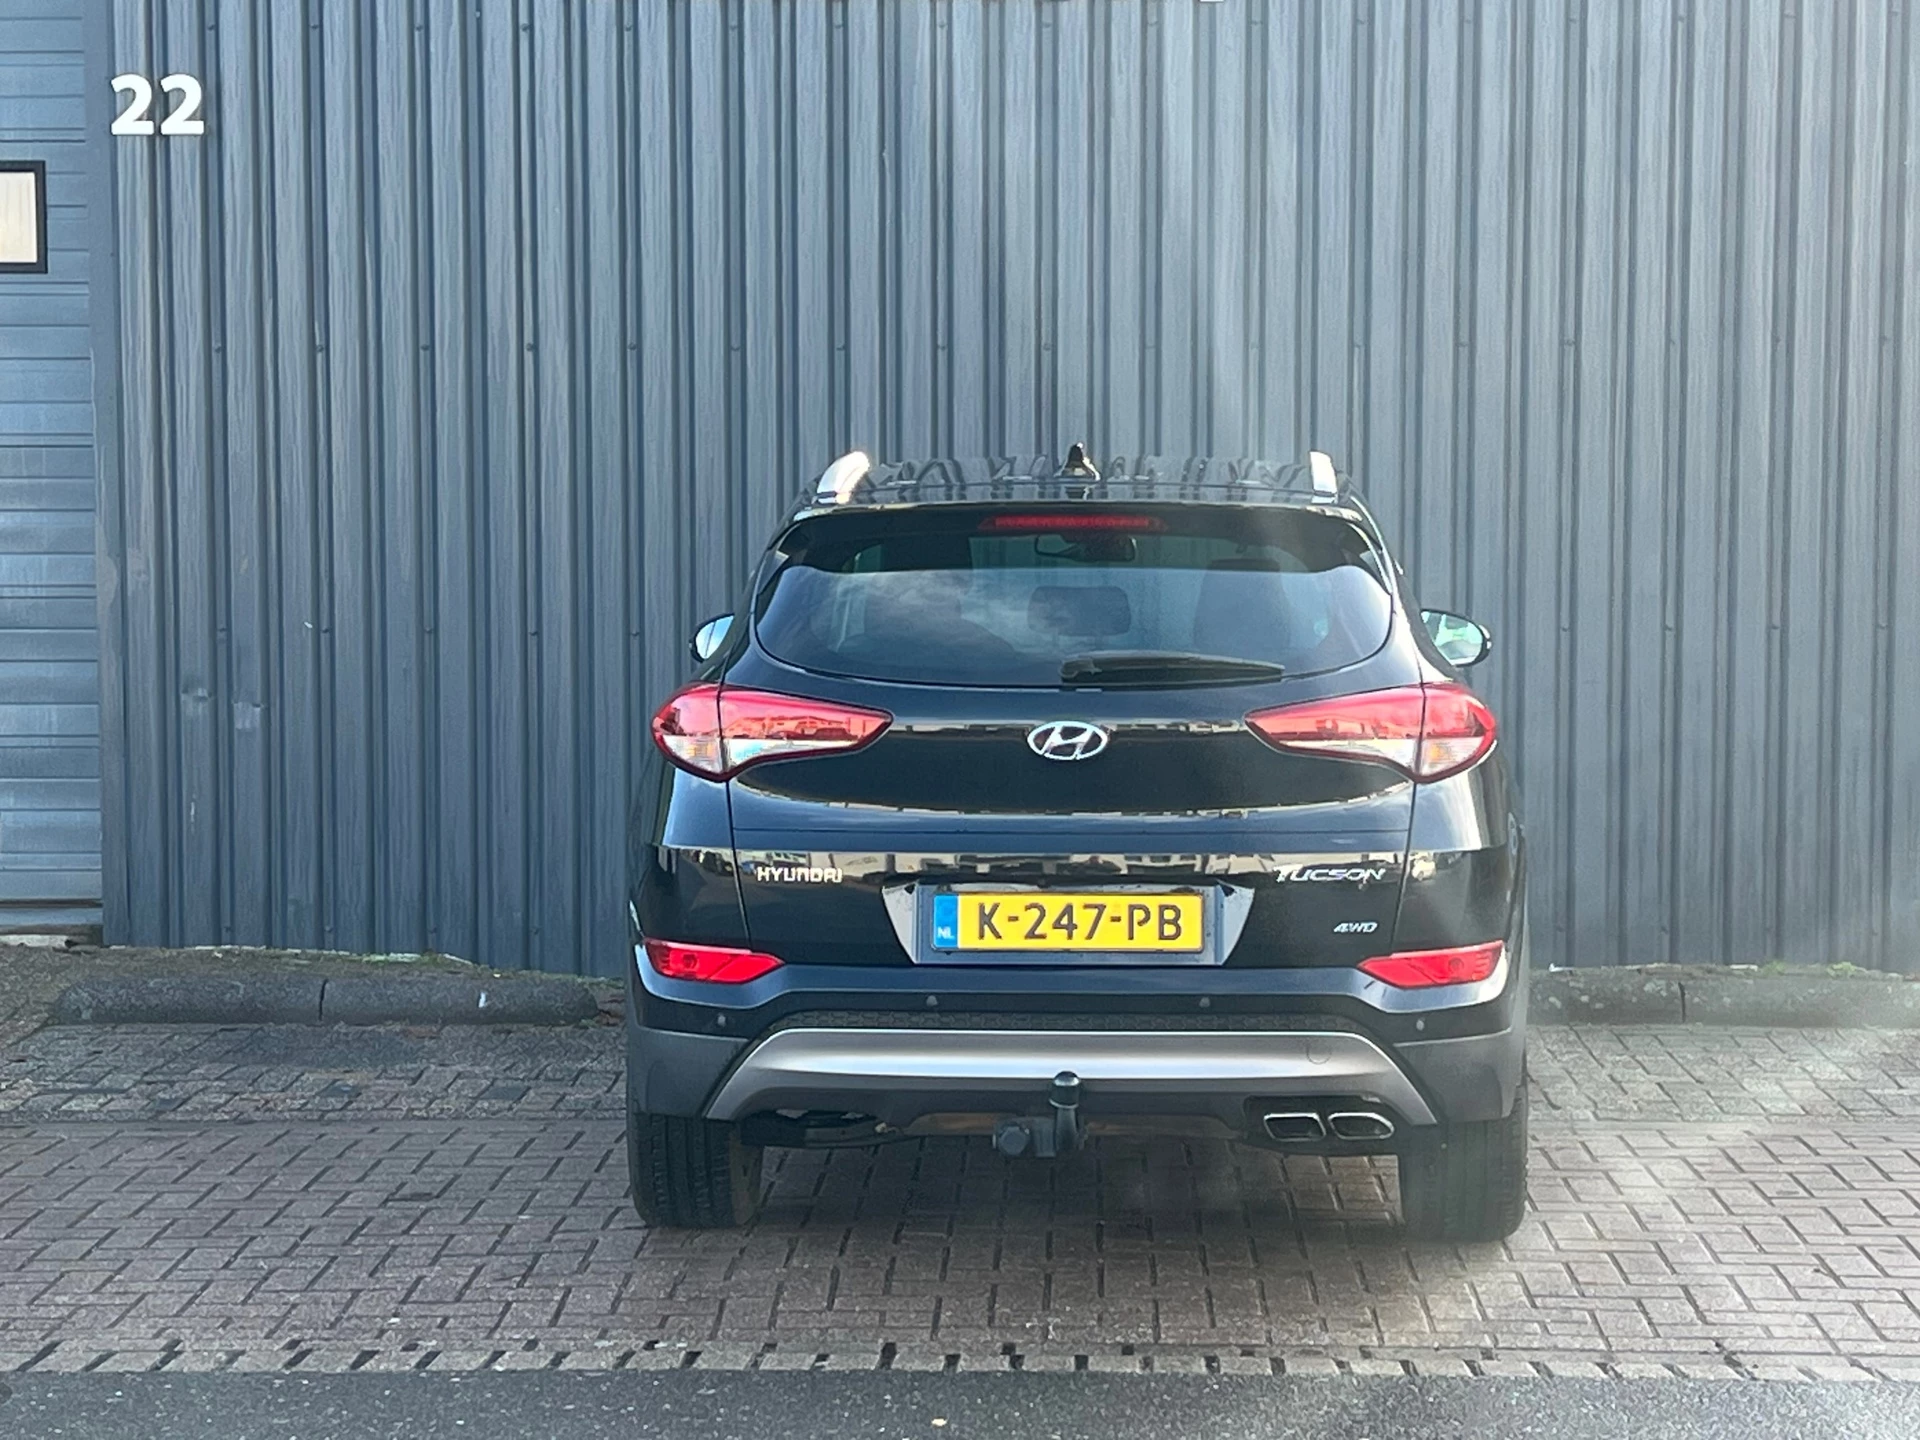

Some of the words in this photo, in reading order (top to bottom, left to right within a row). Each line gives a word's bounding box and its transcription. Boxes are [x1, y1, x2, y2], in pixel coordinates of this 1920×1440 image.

[111, 73, 204, 135] 22
[757, 866, 843, 883] HYUNDAI
[1273, 866, 1386, 883] TUCSON
[978, 902, 1182, 941] K-247-PB
[1333, 922, 1378, 933] 4WD
[937, 926, 955, 939] NL
